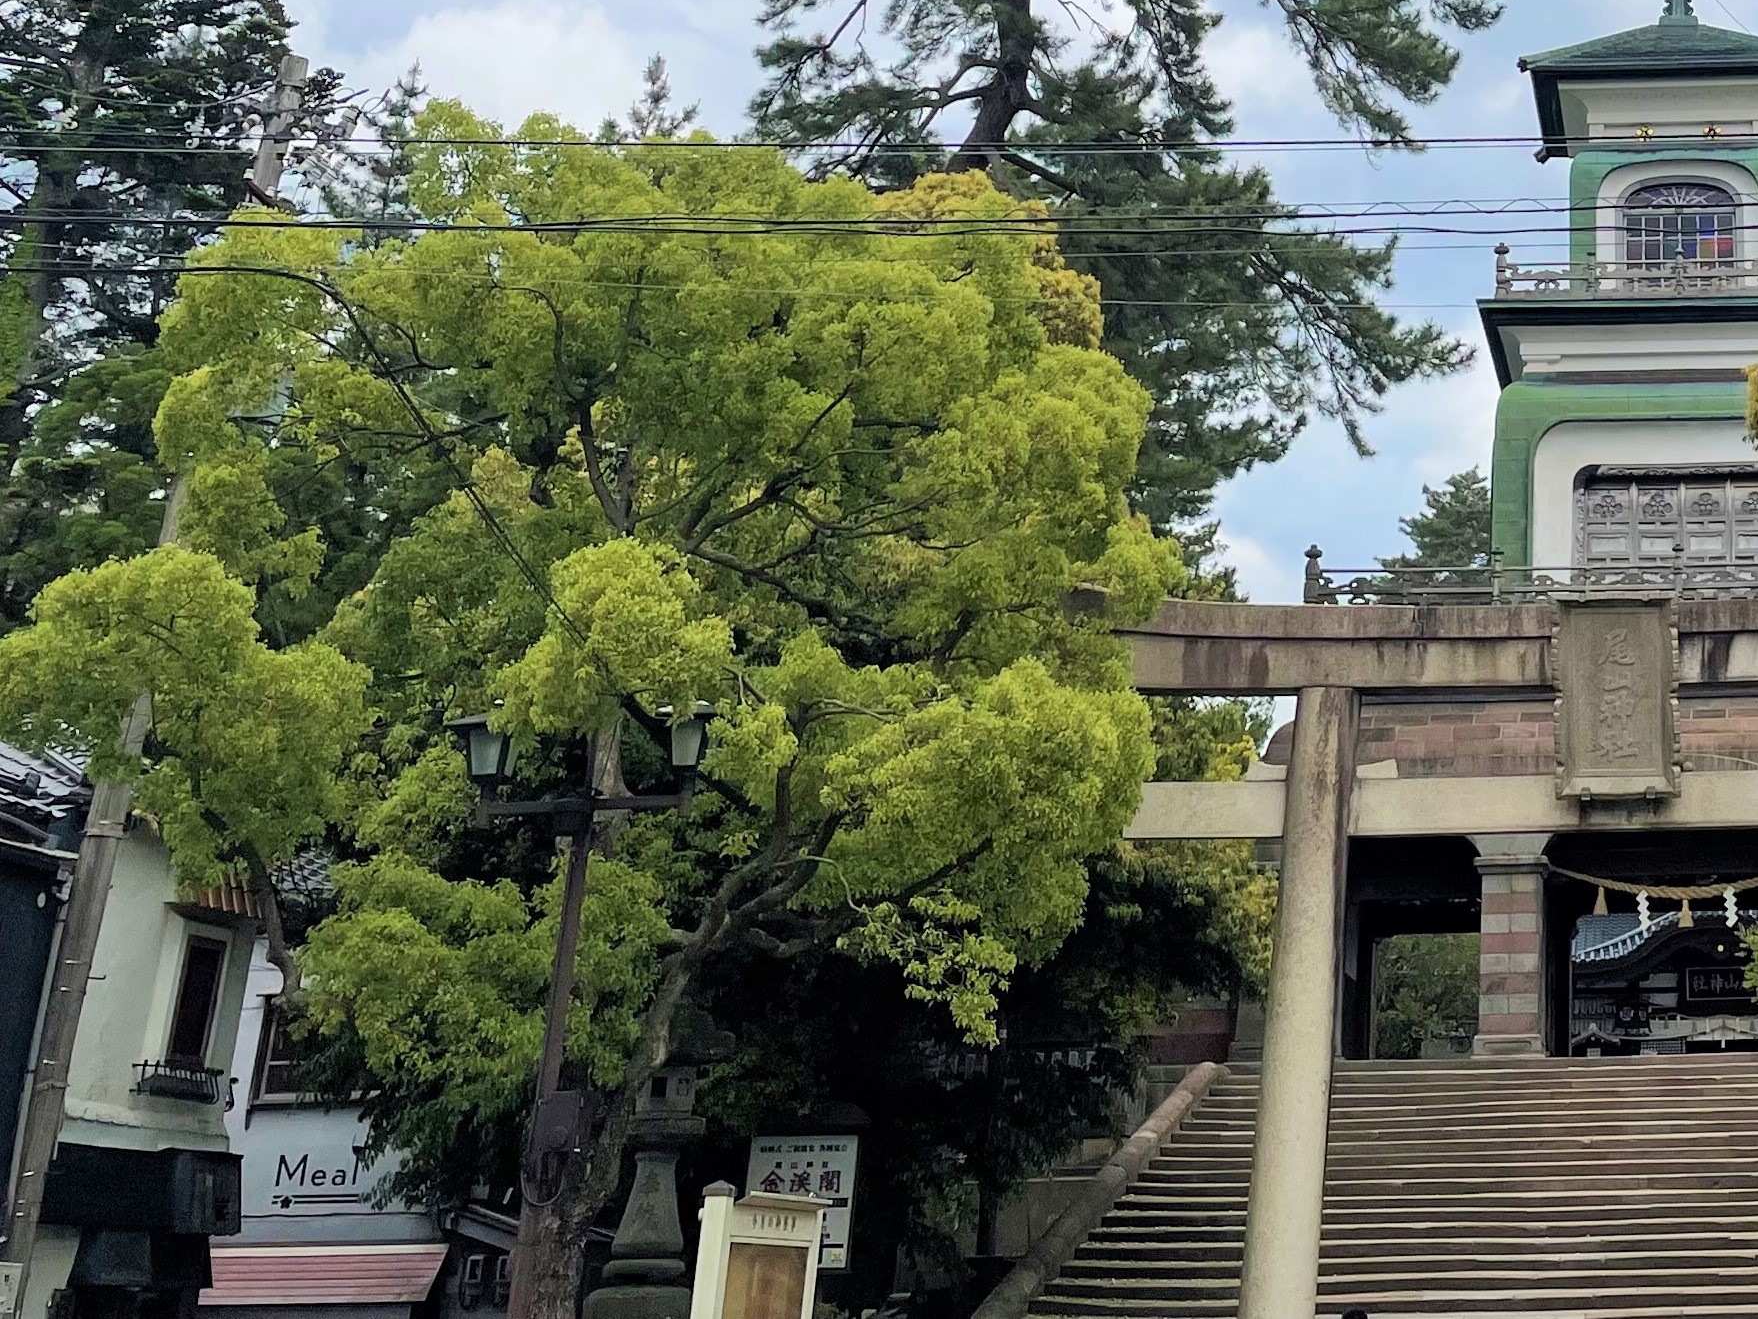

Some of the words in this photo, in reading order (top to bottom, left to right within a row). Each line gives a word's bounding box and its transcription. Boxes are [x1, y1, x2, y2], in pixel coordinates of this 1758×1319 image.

[1591, 628, 1642, 764] 尾山神社
[275, 1153, 360, 1187] Meal
